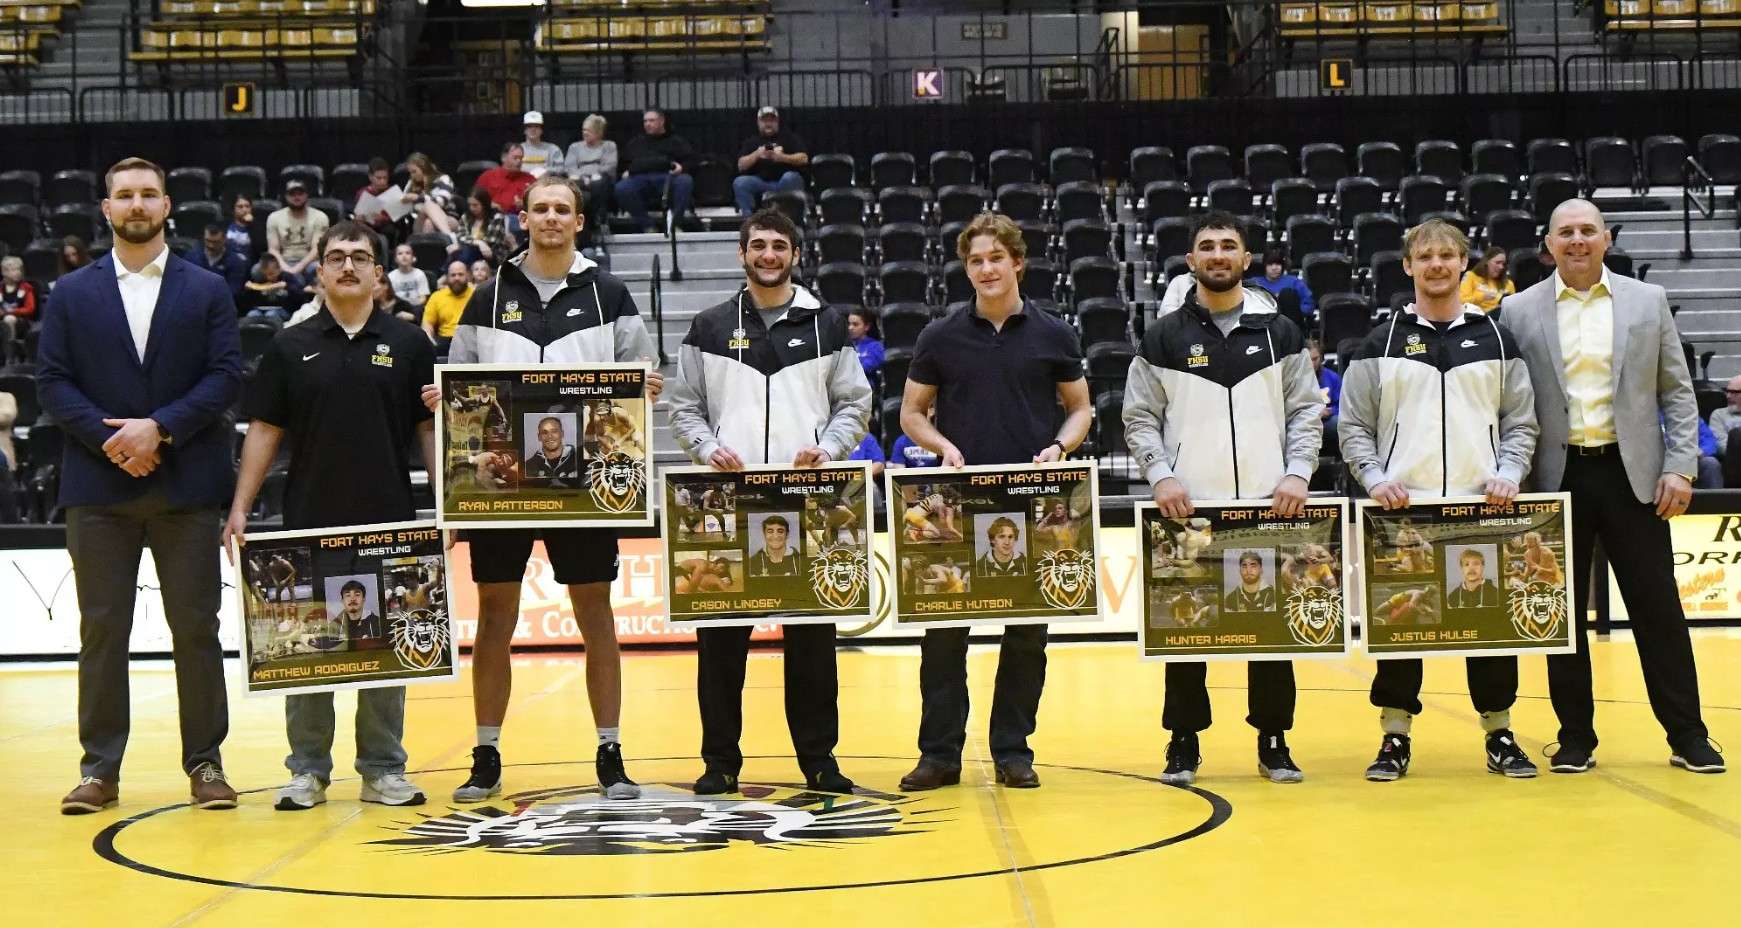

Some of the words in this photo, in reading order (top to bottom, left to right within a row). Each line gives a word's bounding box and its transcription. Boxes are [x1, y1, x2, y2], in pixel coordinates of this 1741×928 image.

[1328, 63, 1345, 86] L
[917, 71, 939, 95] K
[232, 86, 247, 111] J
[521, 373, 556, 384] FORT
[560, 373, 595, 384] HAYS
[599, 372, 641, 383] STATE
[559, 387, 613, 395] WRESTLING
[744, 474, 778, 485] FORT
[782, 473, 817, 483] HAYS
[820, 471, 863, 482] STATE
[971, 474, 1004, 486] FORT
[1008, 473, 1042, 484] HAYS
[1046, 471, 1088, 482] STATE
[781, 485, 834, 495] WRESTLING
[1007, 486, 1060, 495] WRESTLING
[458, 501, 490, 511] RYAN
[493, 500, 563, 510] PATTERSON
[1442, 506, 1475, 516] FORT
[1518, 503, 1560, 513] STATE
[1221, 510, 1254, 520] FORT
[1258, 522, 1310, 530] WRESTLING
[1480, 518, 1532, 526] WRESTLING
[320, 536, 354, 548] FORT
[358, 533, 393, 545] HAYS
[397, 530, 439, 542] STATE
[358, 545, 411, 556] WRESTLING
[691, 600, 730, 610] CASON
[734, 599, 781, 609] LINDSEY
[915, 601, 962, 611] CHARLIE
[966, 599, 1013, 609] HUTSON
[1165, 635, 1211, 645] HUNTER
[1215, 634, 1257, 644] HARRIS
[1390, 631, 1436, 641] JUSTUS
[1439, 630, 1478, 640] HULSE
[253, 667, 310, 680] MATTHEW
[314, 661, 380, 675] RODRIGUEZ
